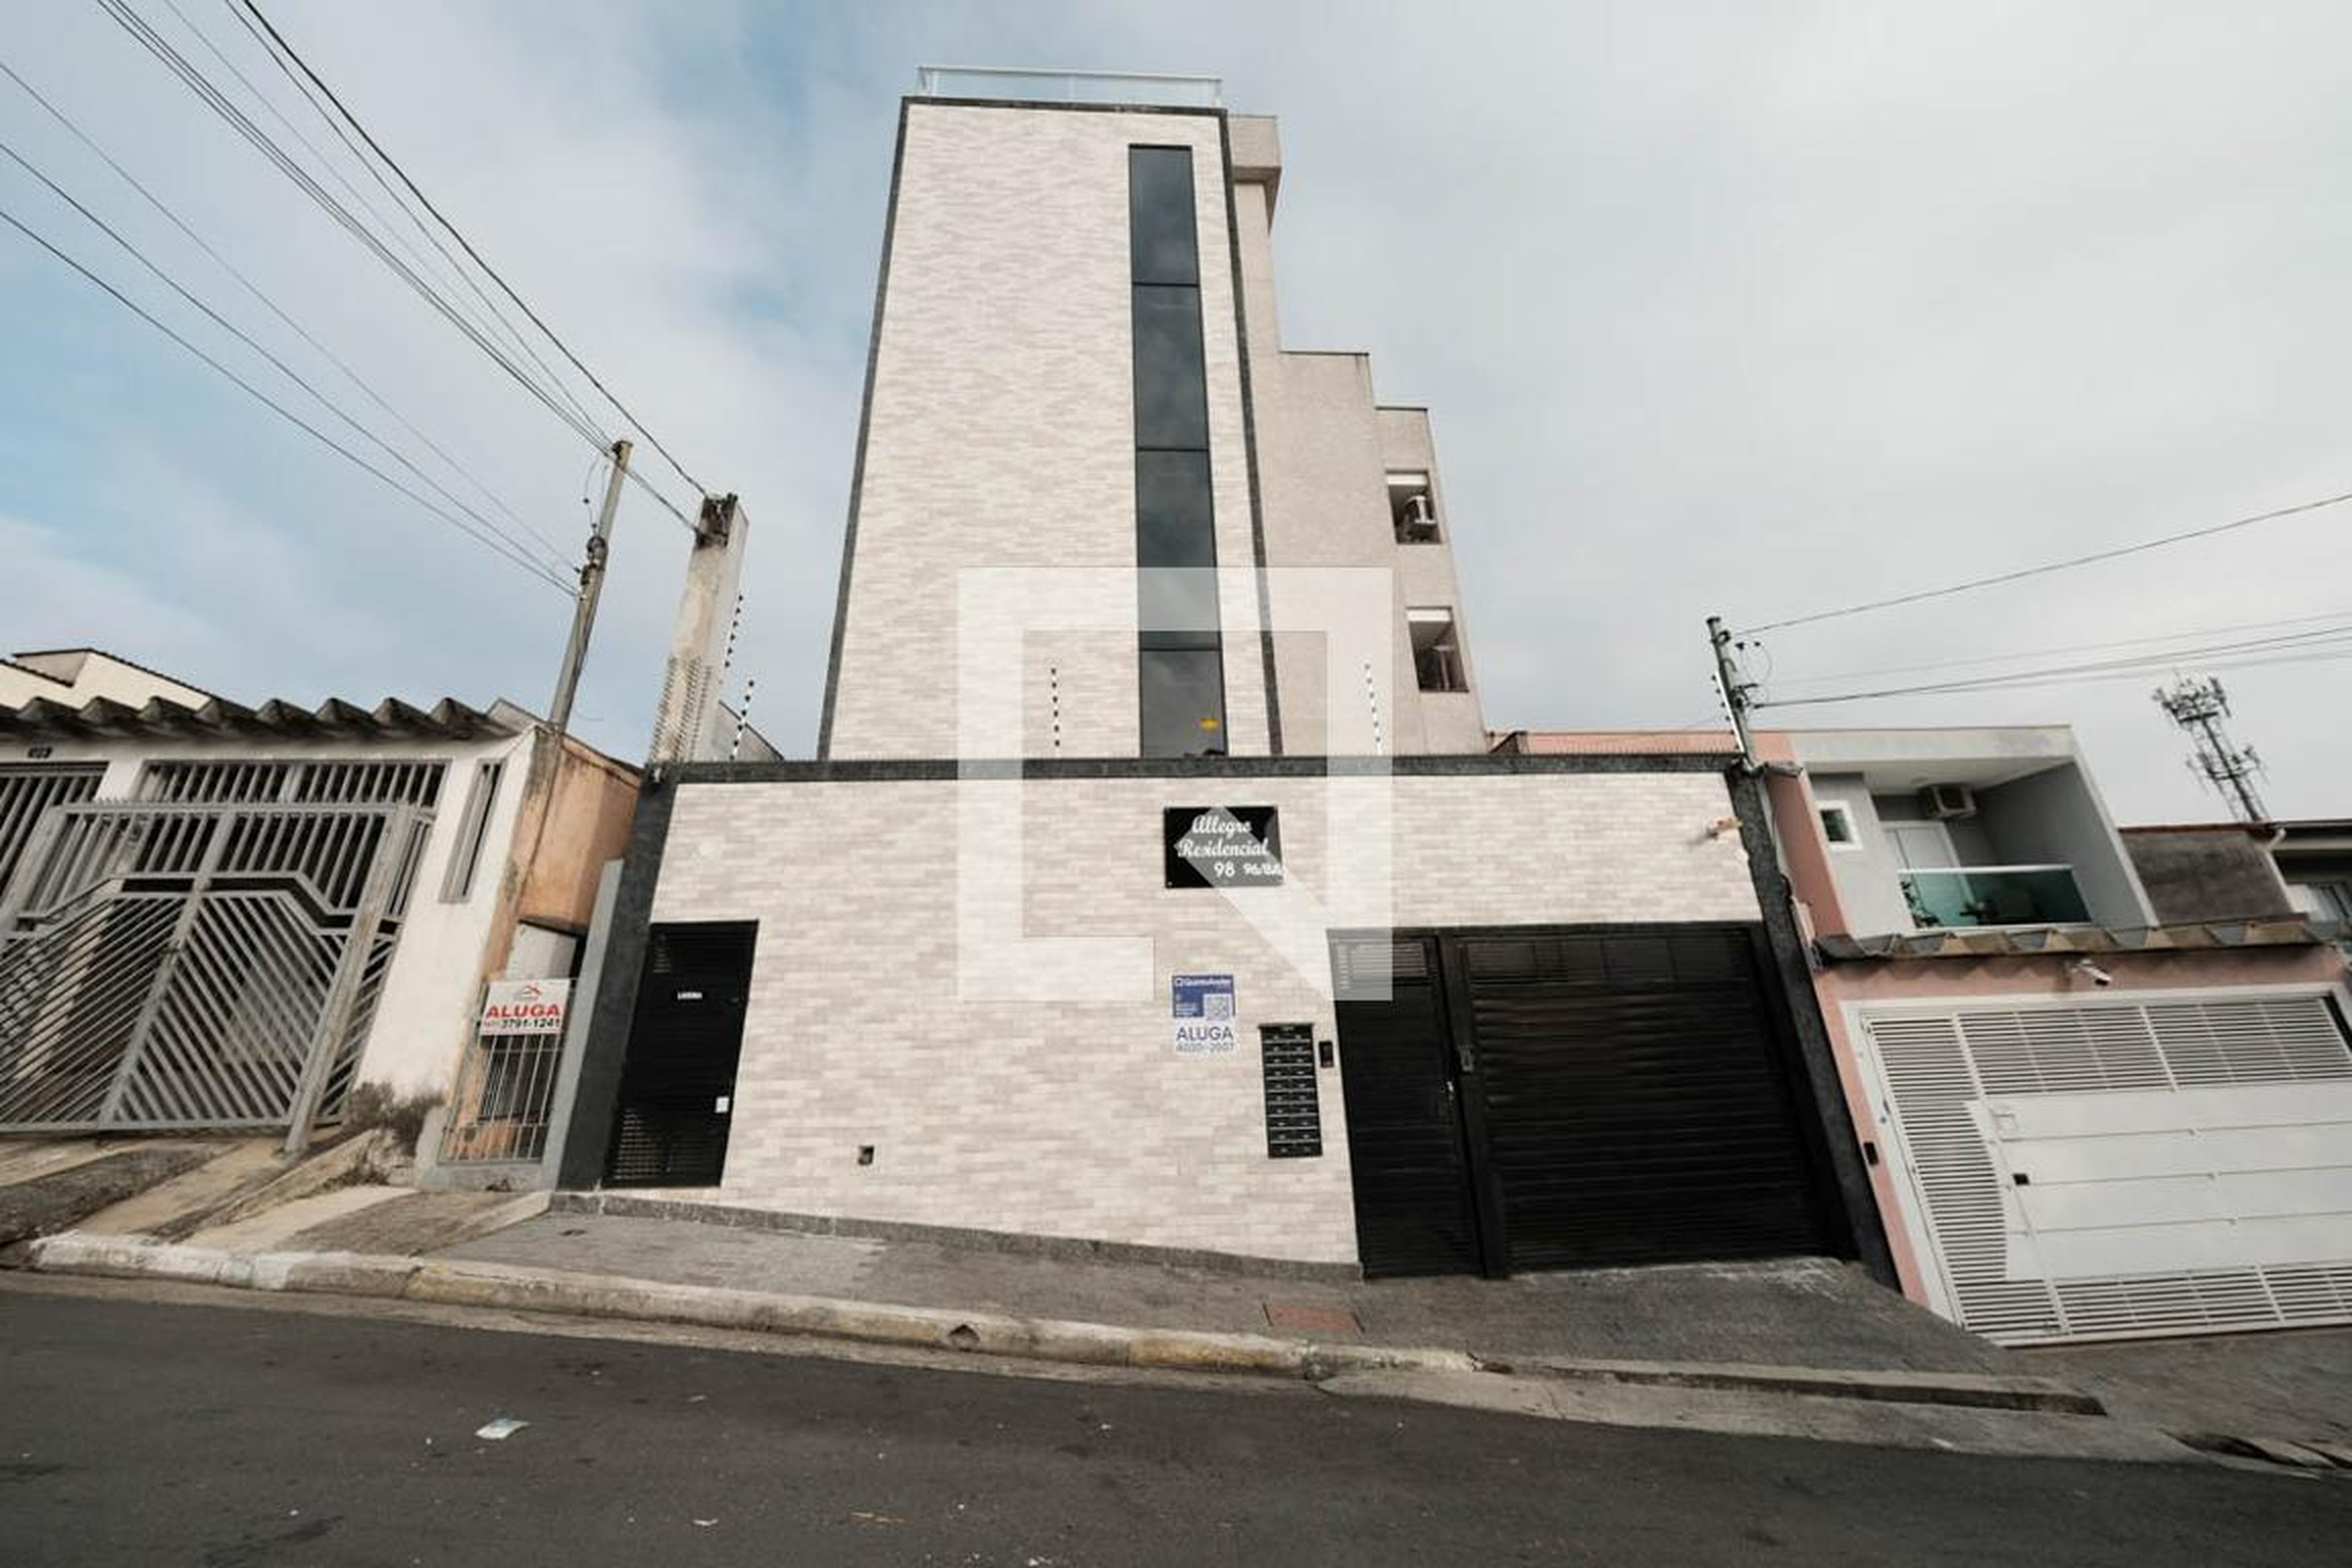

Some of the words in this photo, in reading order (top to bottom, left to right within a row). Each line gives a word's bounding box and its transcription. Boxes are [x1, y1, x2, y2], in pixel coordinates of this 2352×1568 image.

[1177, 838, 1268, 857] Residencial
[1214, 861, 1235, 877] 98
[486, 1003, 560, 1019] ALUGA
[1176, 1027, 1234, 1041] ALUGA
